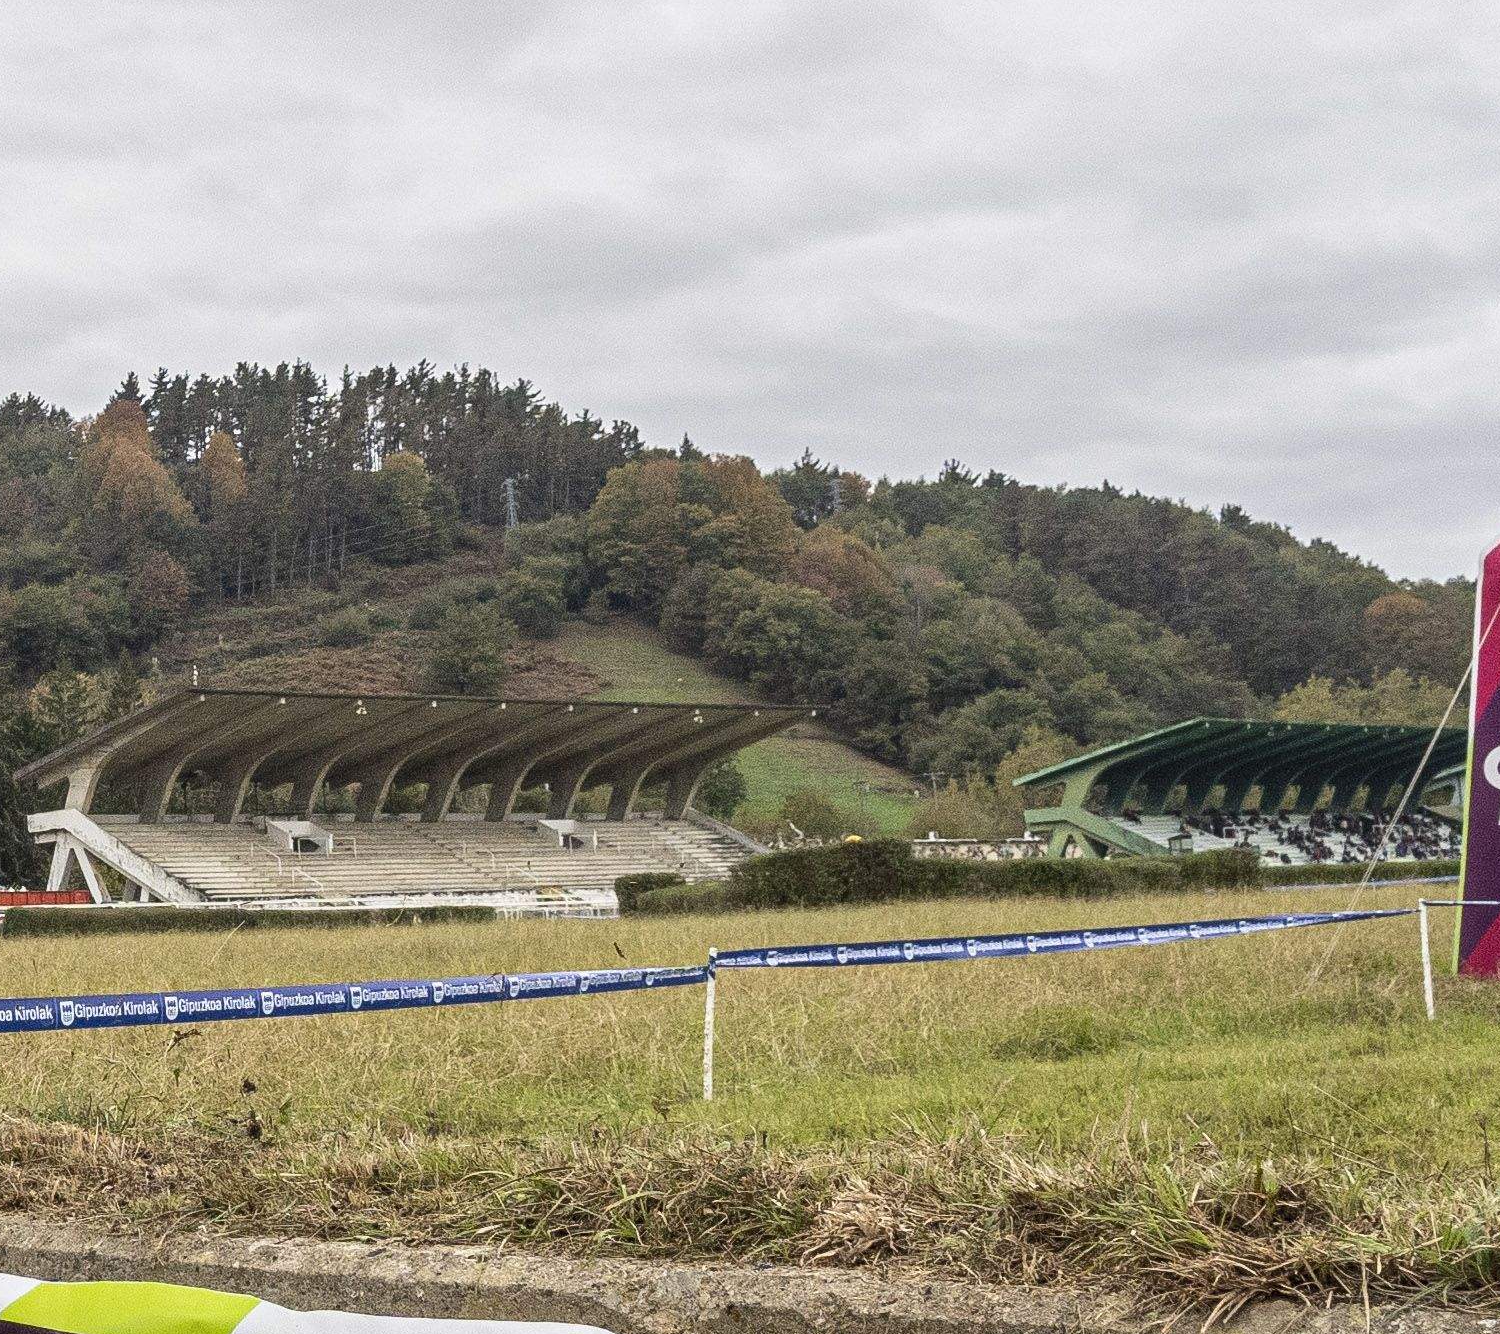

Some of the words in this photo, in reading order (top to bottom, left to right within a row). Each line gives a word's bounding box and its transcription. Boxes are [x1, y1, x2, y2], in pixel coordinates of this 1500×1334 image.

[178, 998, 222, 1014] Gipuzkoa
[223, 995, 256, 1011] Kirolak
[274, 993, 314, 1009] Gipuzkoa
[315, 989, 346, 1006] Kirolak
[15, 1004, 54, 1021] Kirolak
[75, 1003, 121, 1019] Gipuzkoa
[123, 999, 159, 1015] Kirolak
